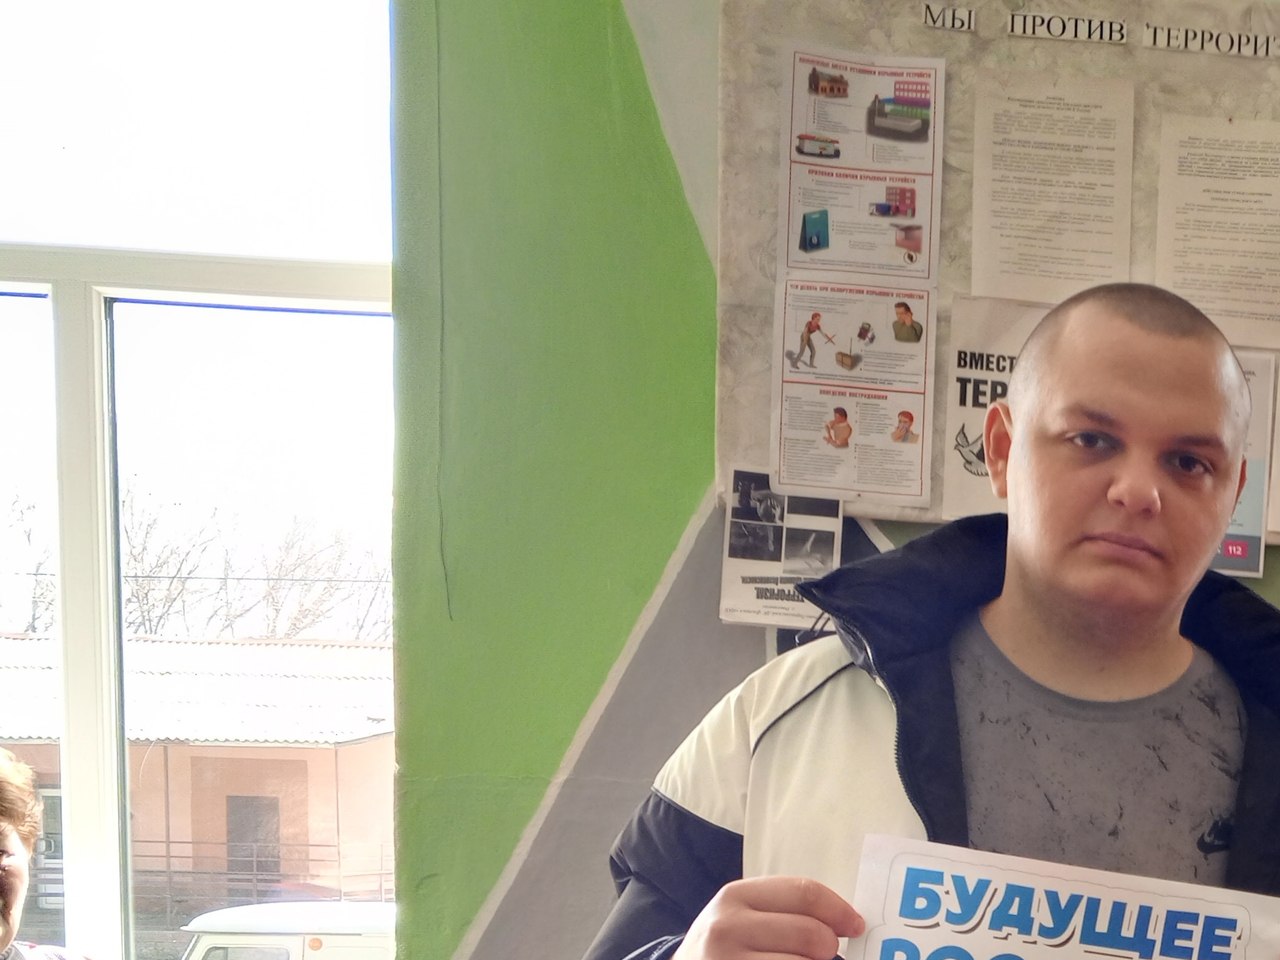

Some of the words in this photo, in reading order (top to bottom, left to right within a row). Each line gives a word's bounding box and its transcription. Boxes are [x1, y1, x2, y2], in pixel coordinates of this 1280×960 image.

[923, 4, 974, 31] МЫ
[1008, 13, 1126, 42] ПРОТИВ
[1229, 545, 1242, 556] 112
